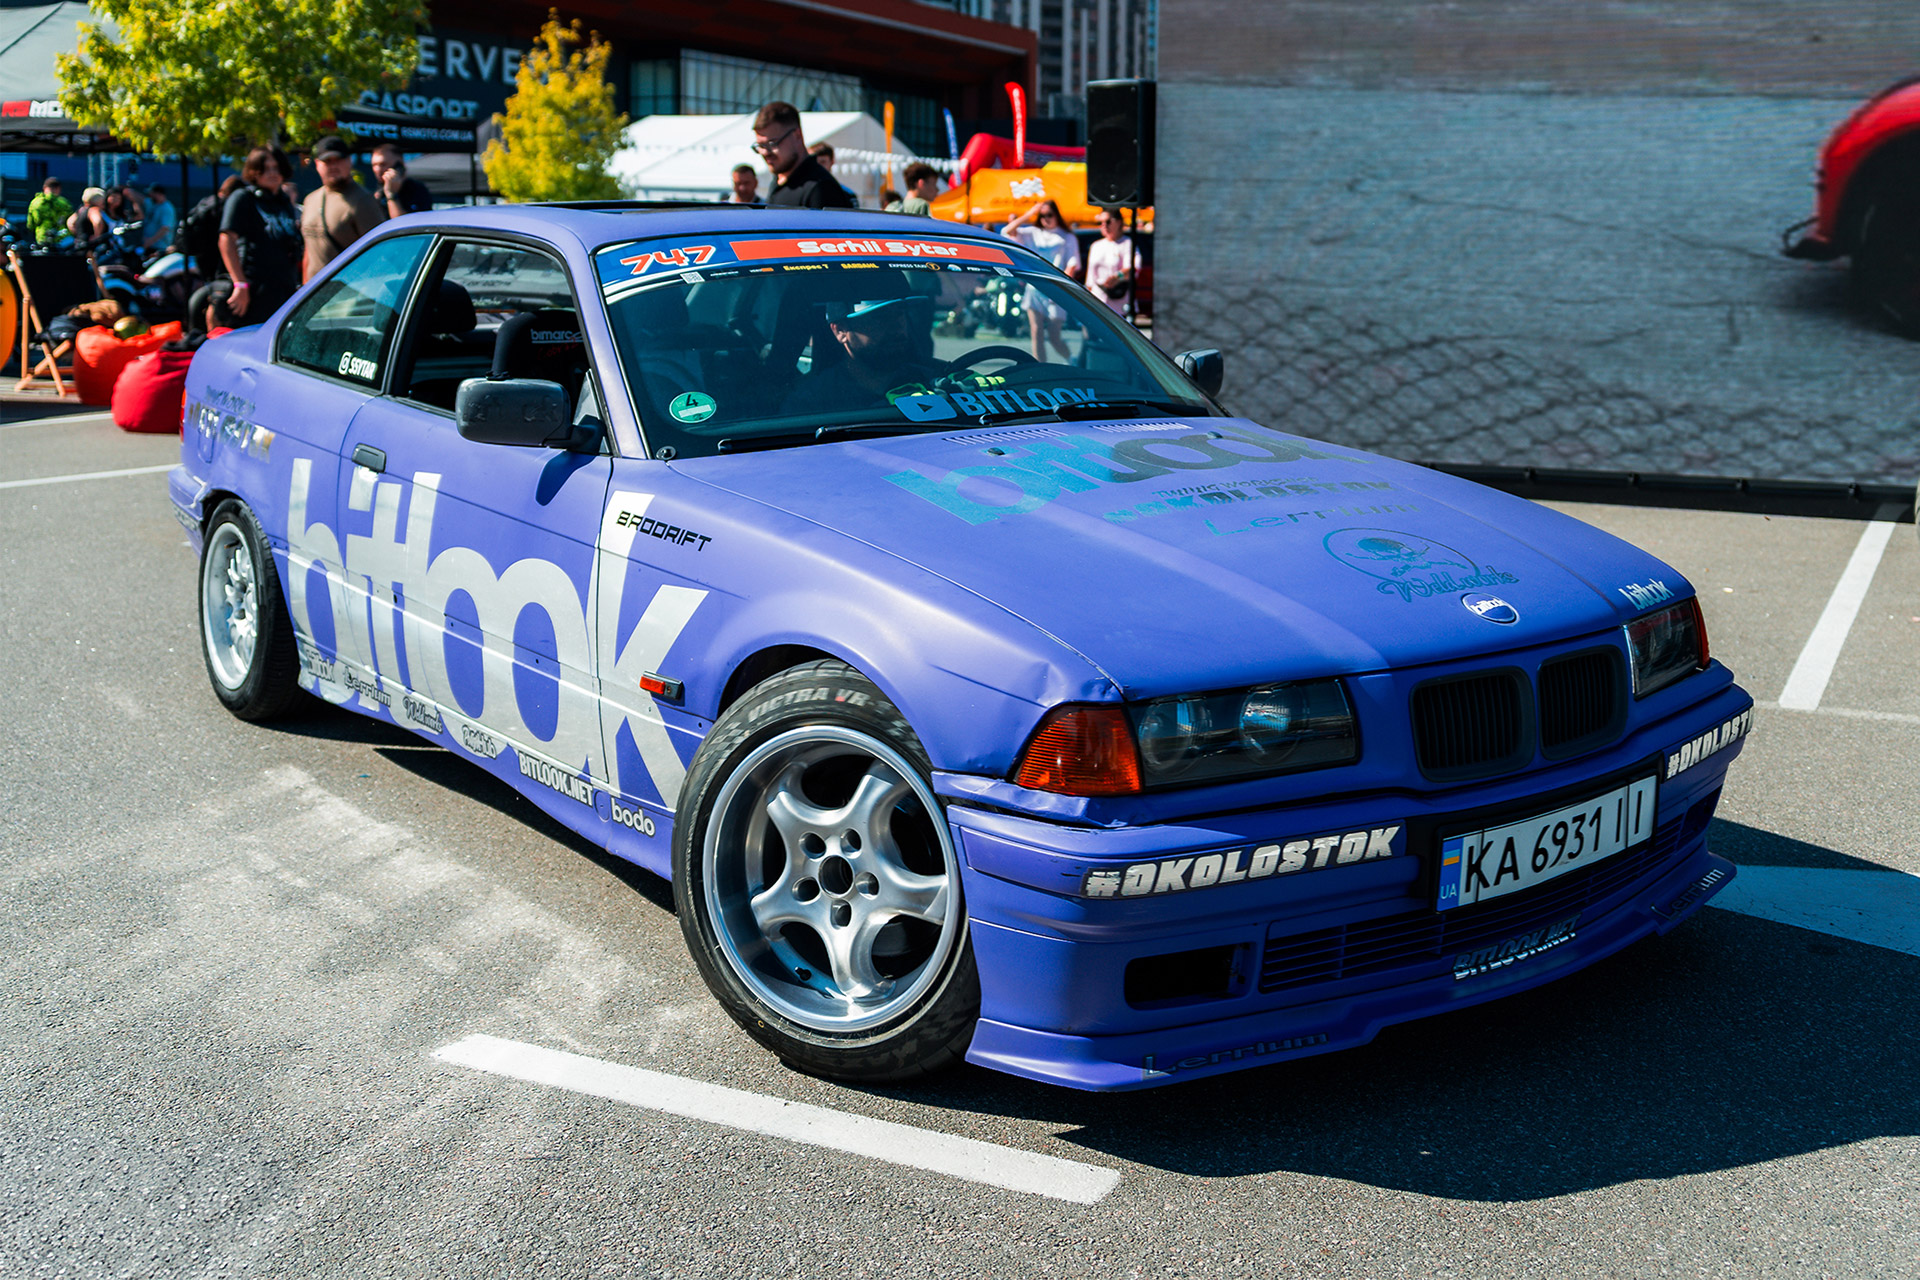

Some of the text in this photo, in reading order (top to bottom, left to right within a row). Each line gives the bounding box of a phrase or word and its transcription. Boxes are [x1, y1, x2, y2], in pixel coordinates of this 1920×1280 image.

[416, 34, 522, 86] ERVE
[1, 100, 64, 118] RSMO
[620, 244, 716, 275] 747
[797, 240, 958, 257] Serhii Sytar
[349, 357, 378, 379] SSYTAR
[686, 394, 698, 407] 4
[881, 426, 1373, 526] bitlook
[616, 510, 712, 552] BRODRIFT
[1618, 578, 1675, 611] bitlook
[287, 458, 709, 813] bitlook
[518, 752, 593, 807] BITLOOK.NET
[611, 796, 656, 837] bodo
[1085, 825, 1400, 898] #OKOLOSTOK
[1464, 835, 1520, 893] KA
[1530, 806, 1603, 874] 6931
[1440, 882, 1458, 900] UA
